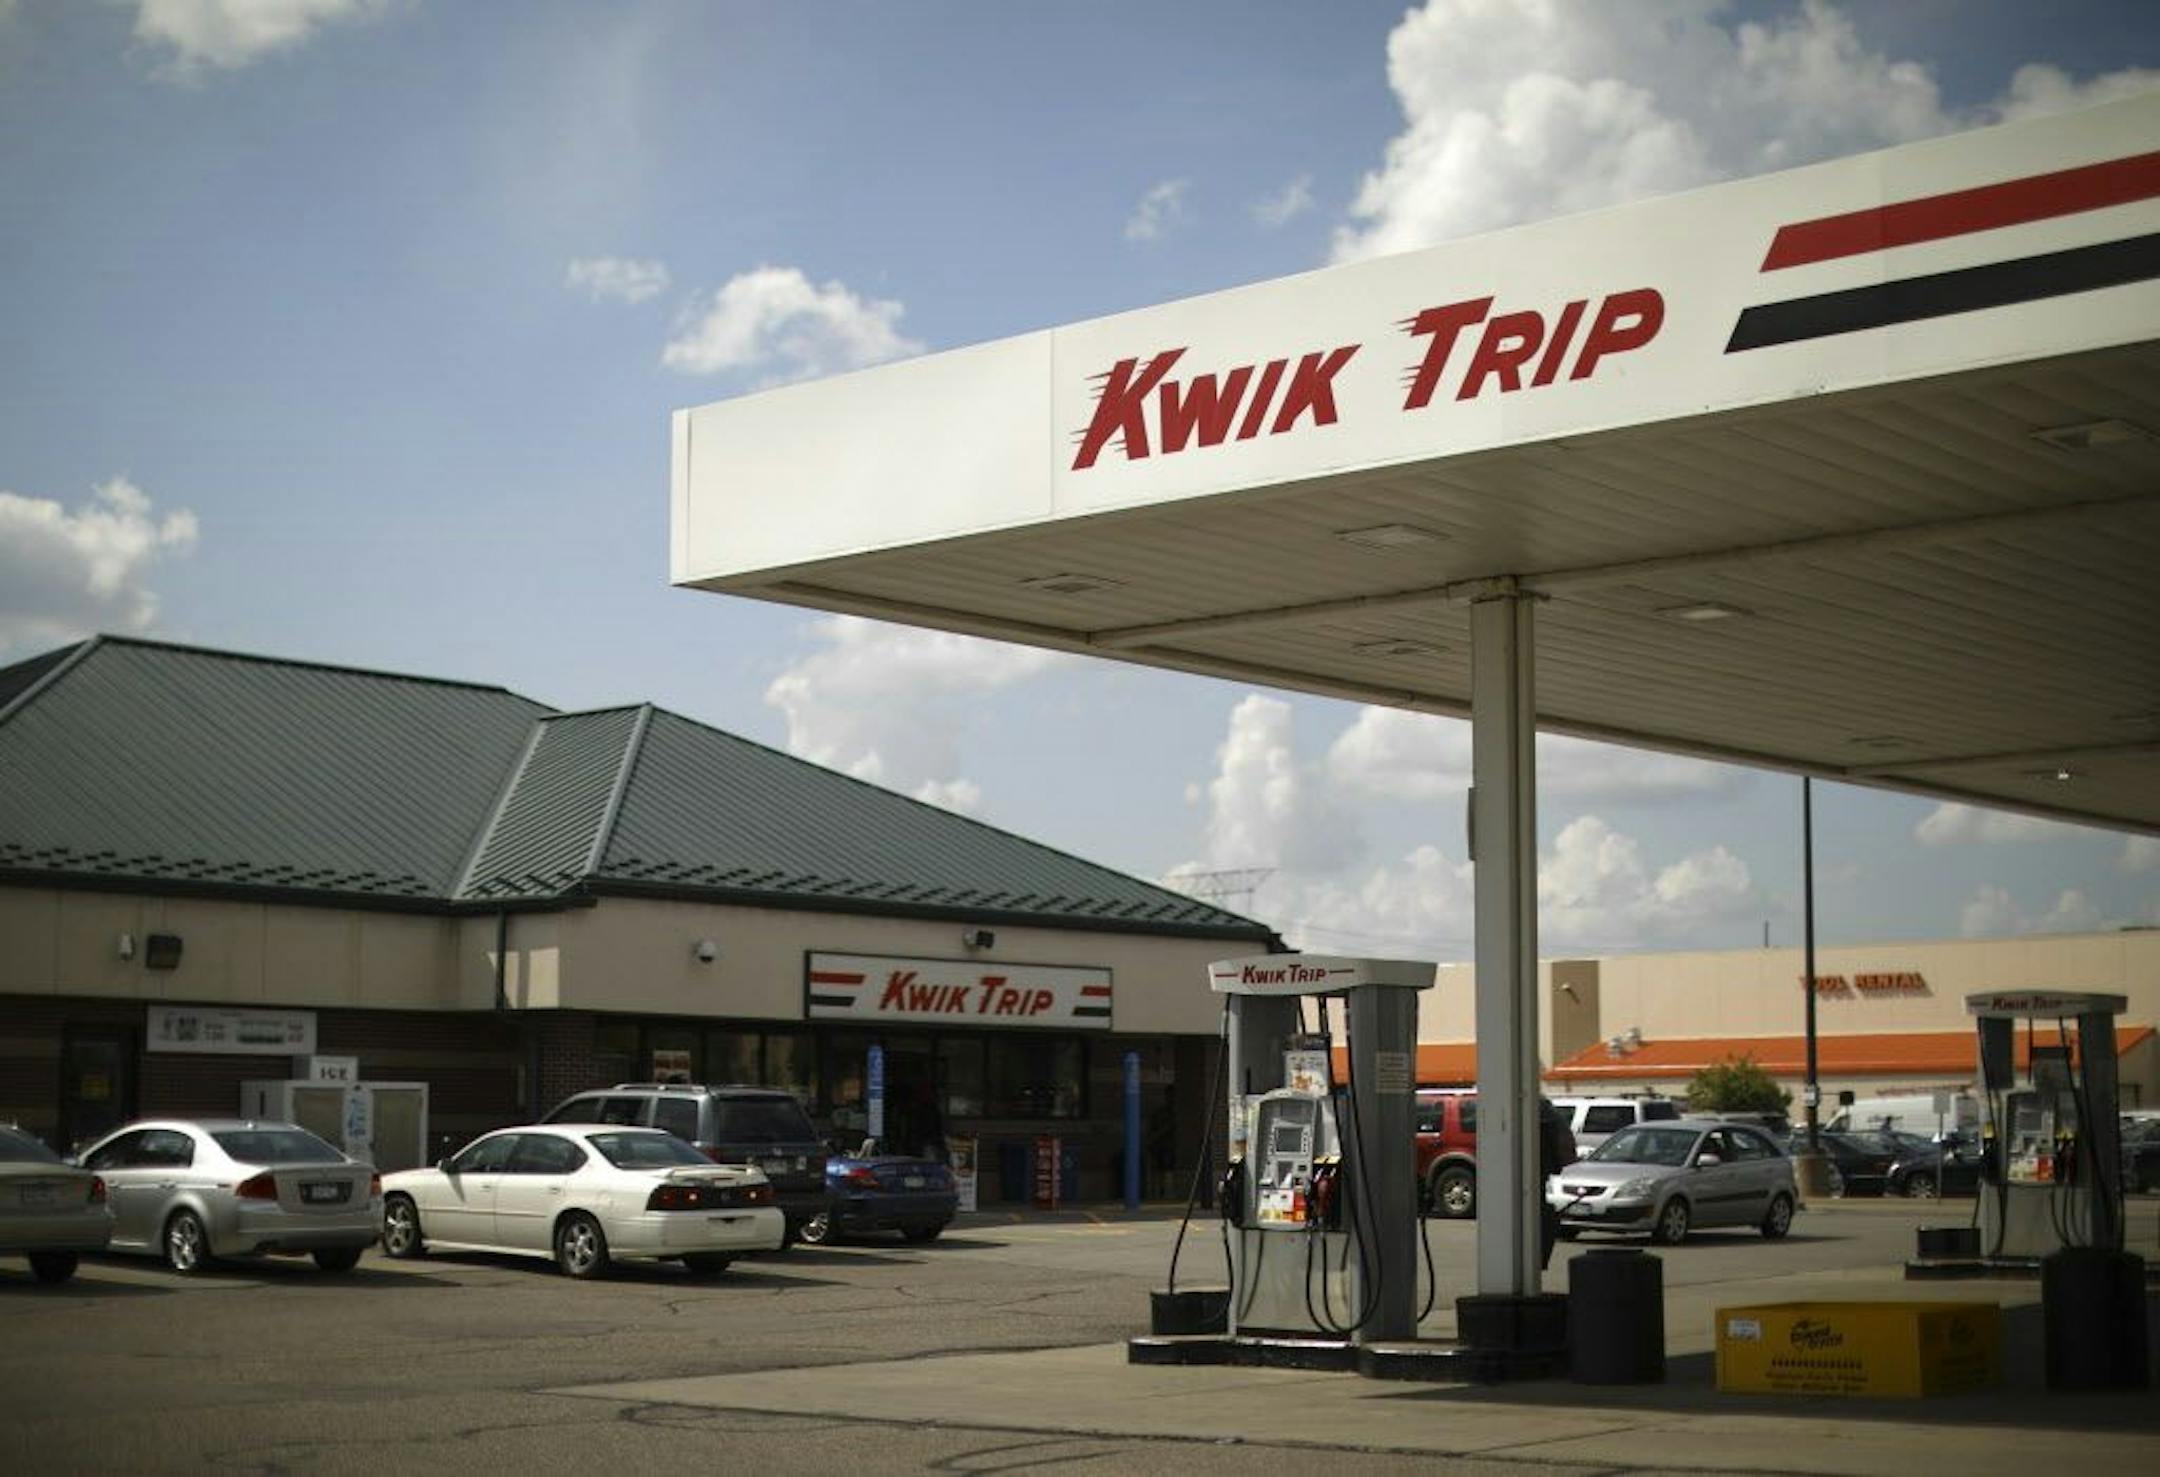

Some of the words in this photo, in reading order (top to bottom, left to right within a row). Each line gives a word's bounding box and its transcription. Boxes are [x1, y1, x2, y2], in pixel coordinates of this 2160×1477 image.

[1071, 344, 1362, 471] KWIK
[1396, 286, 1666, 412] TRIP
[1242, 965, 1287, 984] KWIK
[1288, 964, 1327, 983] TRIP
[879, 970, 970, 1013] KWIK
[978, 976, 1055, 1016] TRIP
[319, 1066, 349, 1081] ICE
